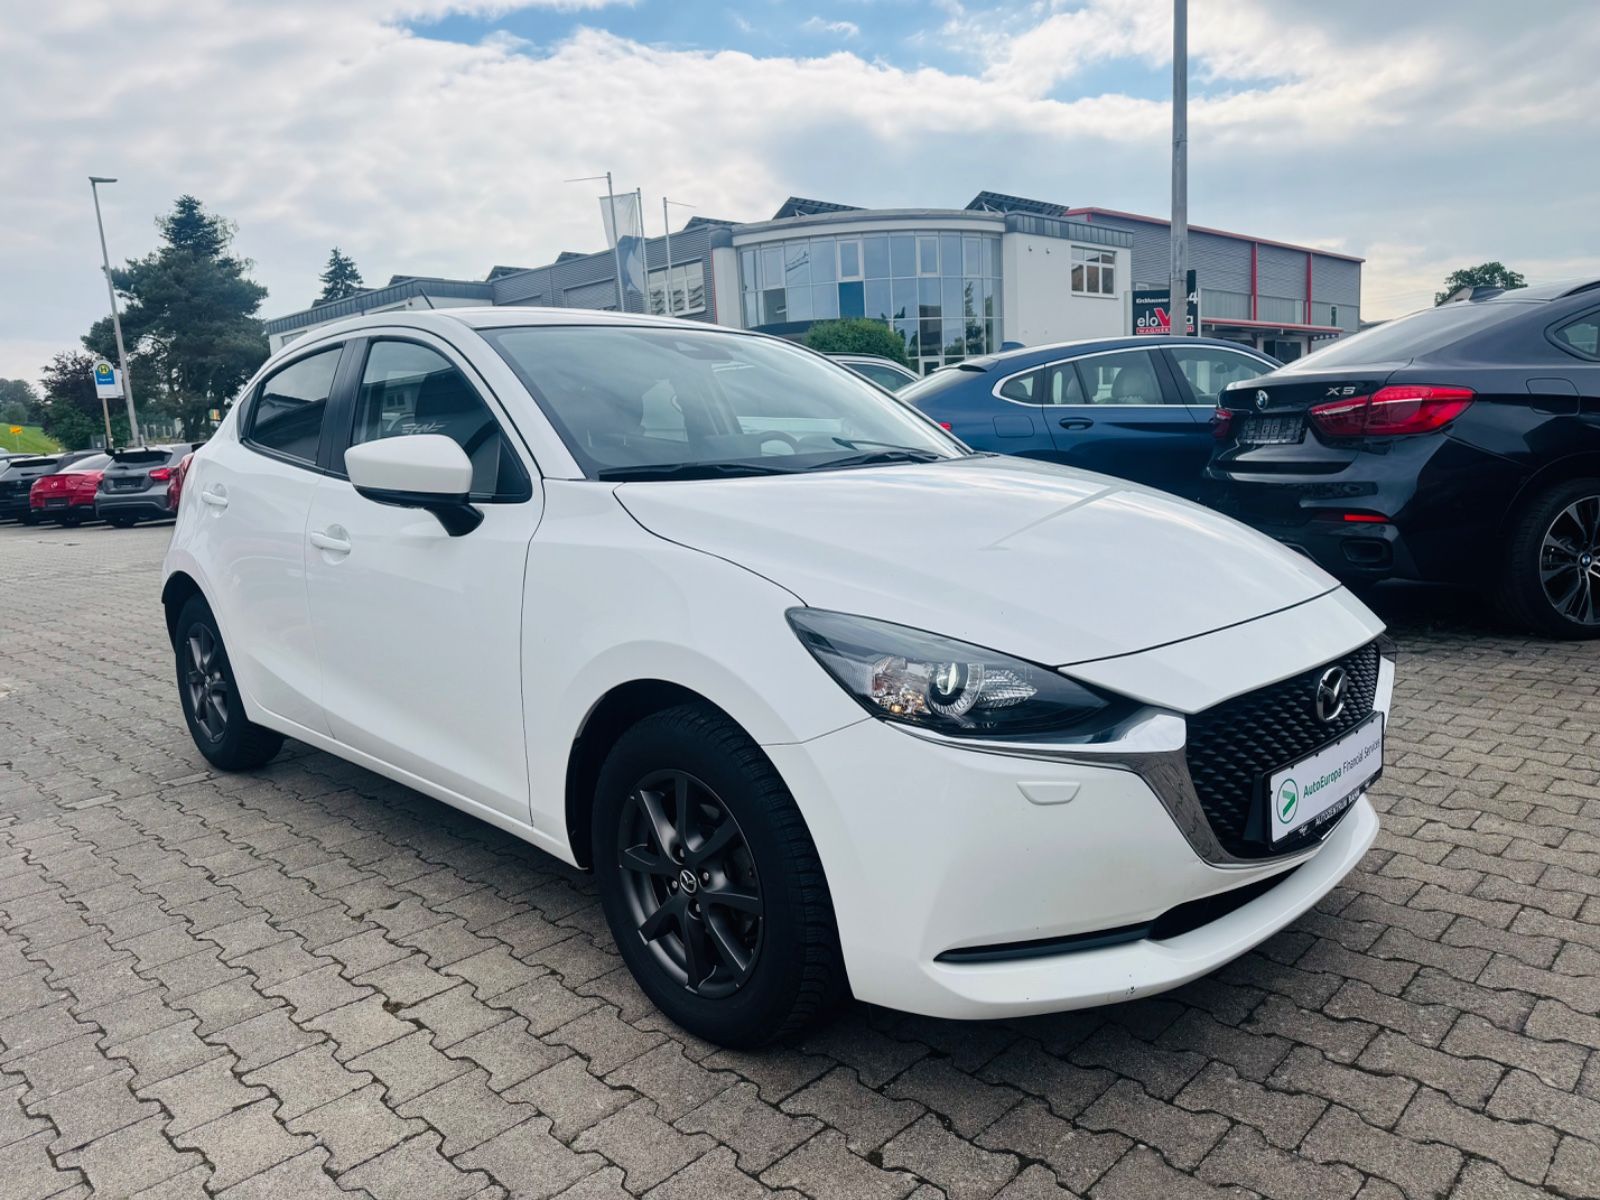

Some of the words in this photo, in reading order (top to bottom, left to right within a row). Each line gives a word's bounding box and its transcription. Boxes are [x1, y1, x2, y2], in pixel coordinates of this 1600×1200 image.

[1303, 767, 1342, 799] AutoEuropa
[1342, 748, 1363, 774] Financial
[1364, 738, 1381, 759] Services
